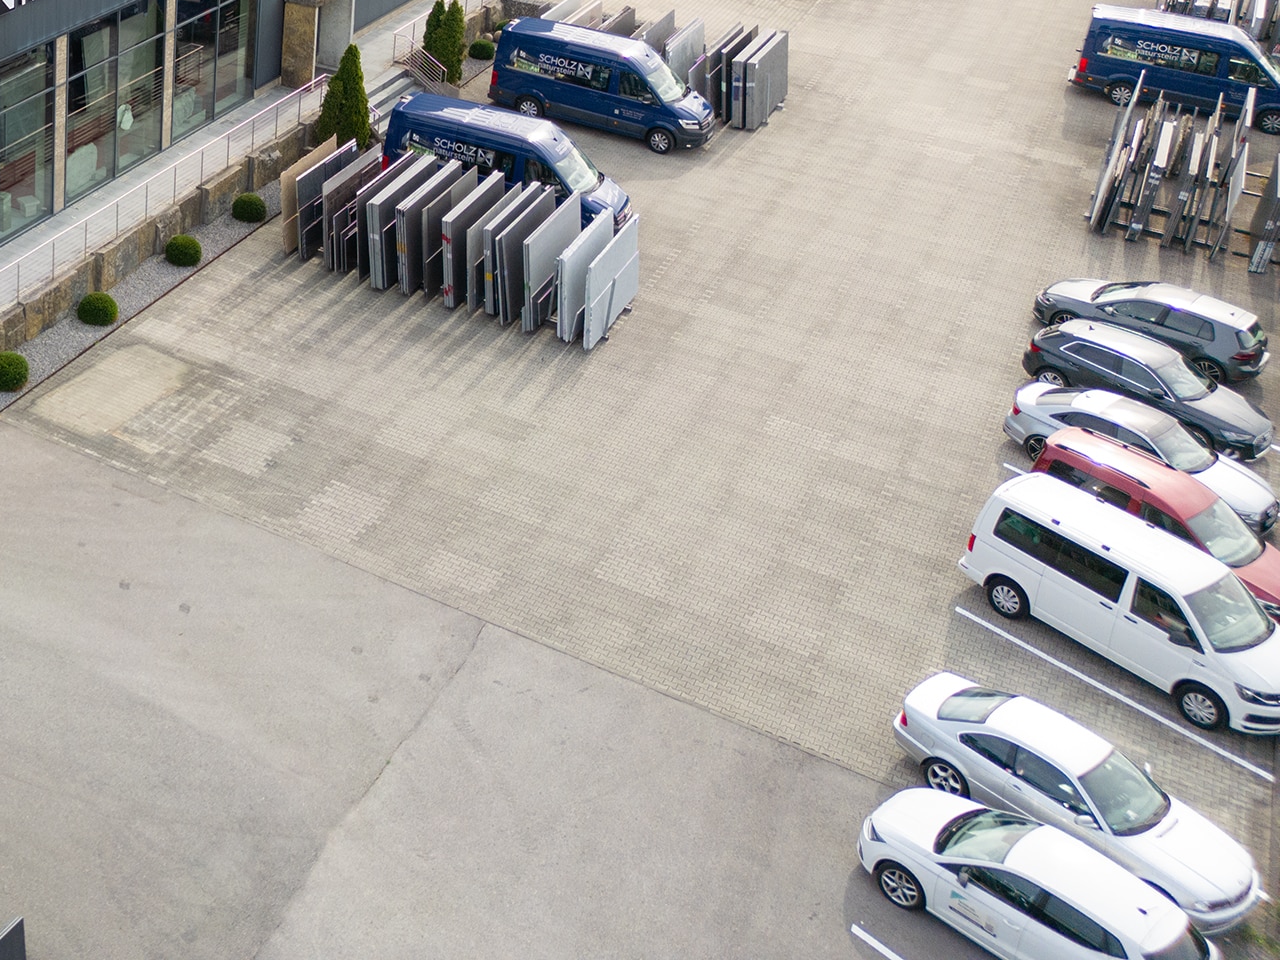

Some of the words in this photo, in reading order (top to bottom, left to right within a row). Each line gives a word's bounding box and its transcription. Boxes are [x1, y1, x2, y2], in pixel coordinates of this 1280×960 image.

[1136, 40, 1182, 55] SCHOLZ
[539, 53, 578, 70] SCHOLZ
[434, 137, 477, 156] SCHOLZ
